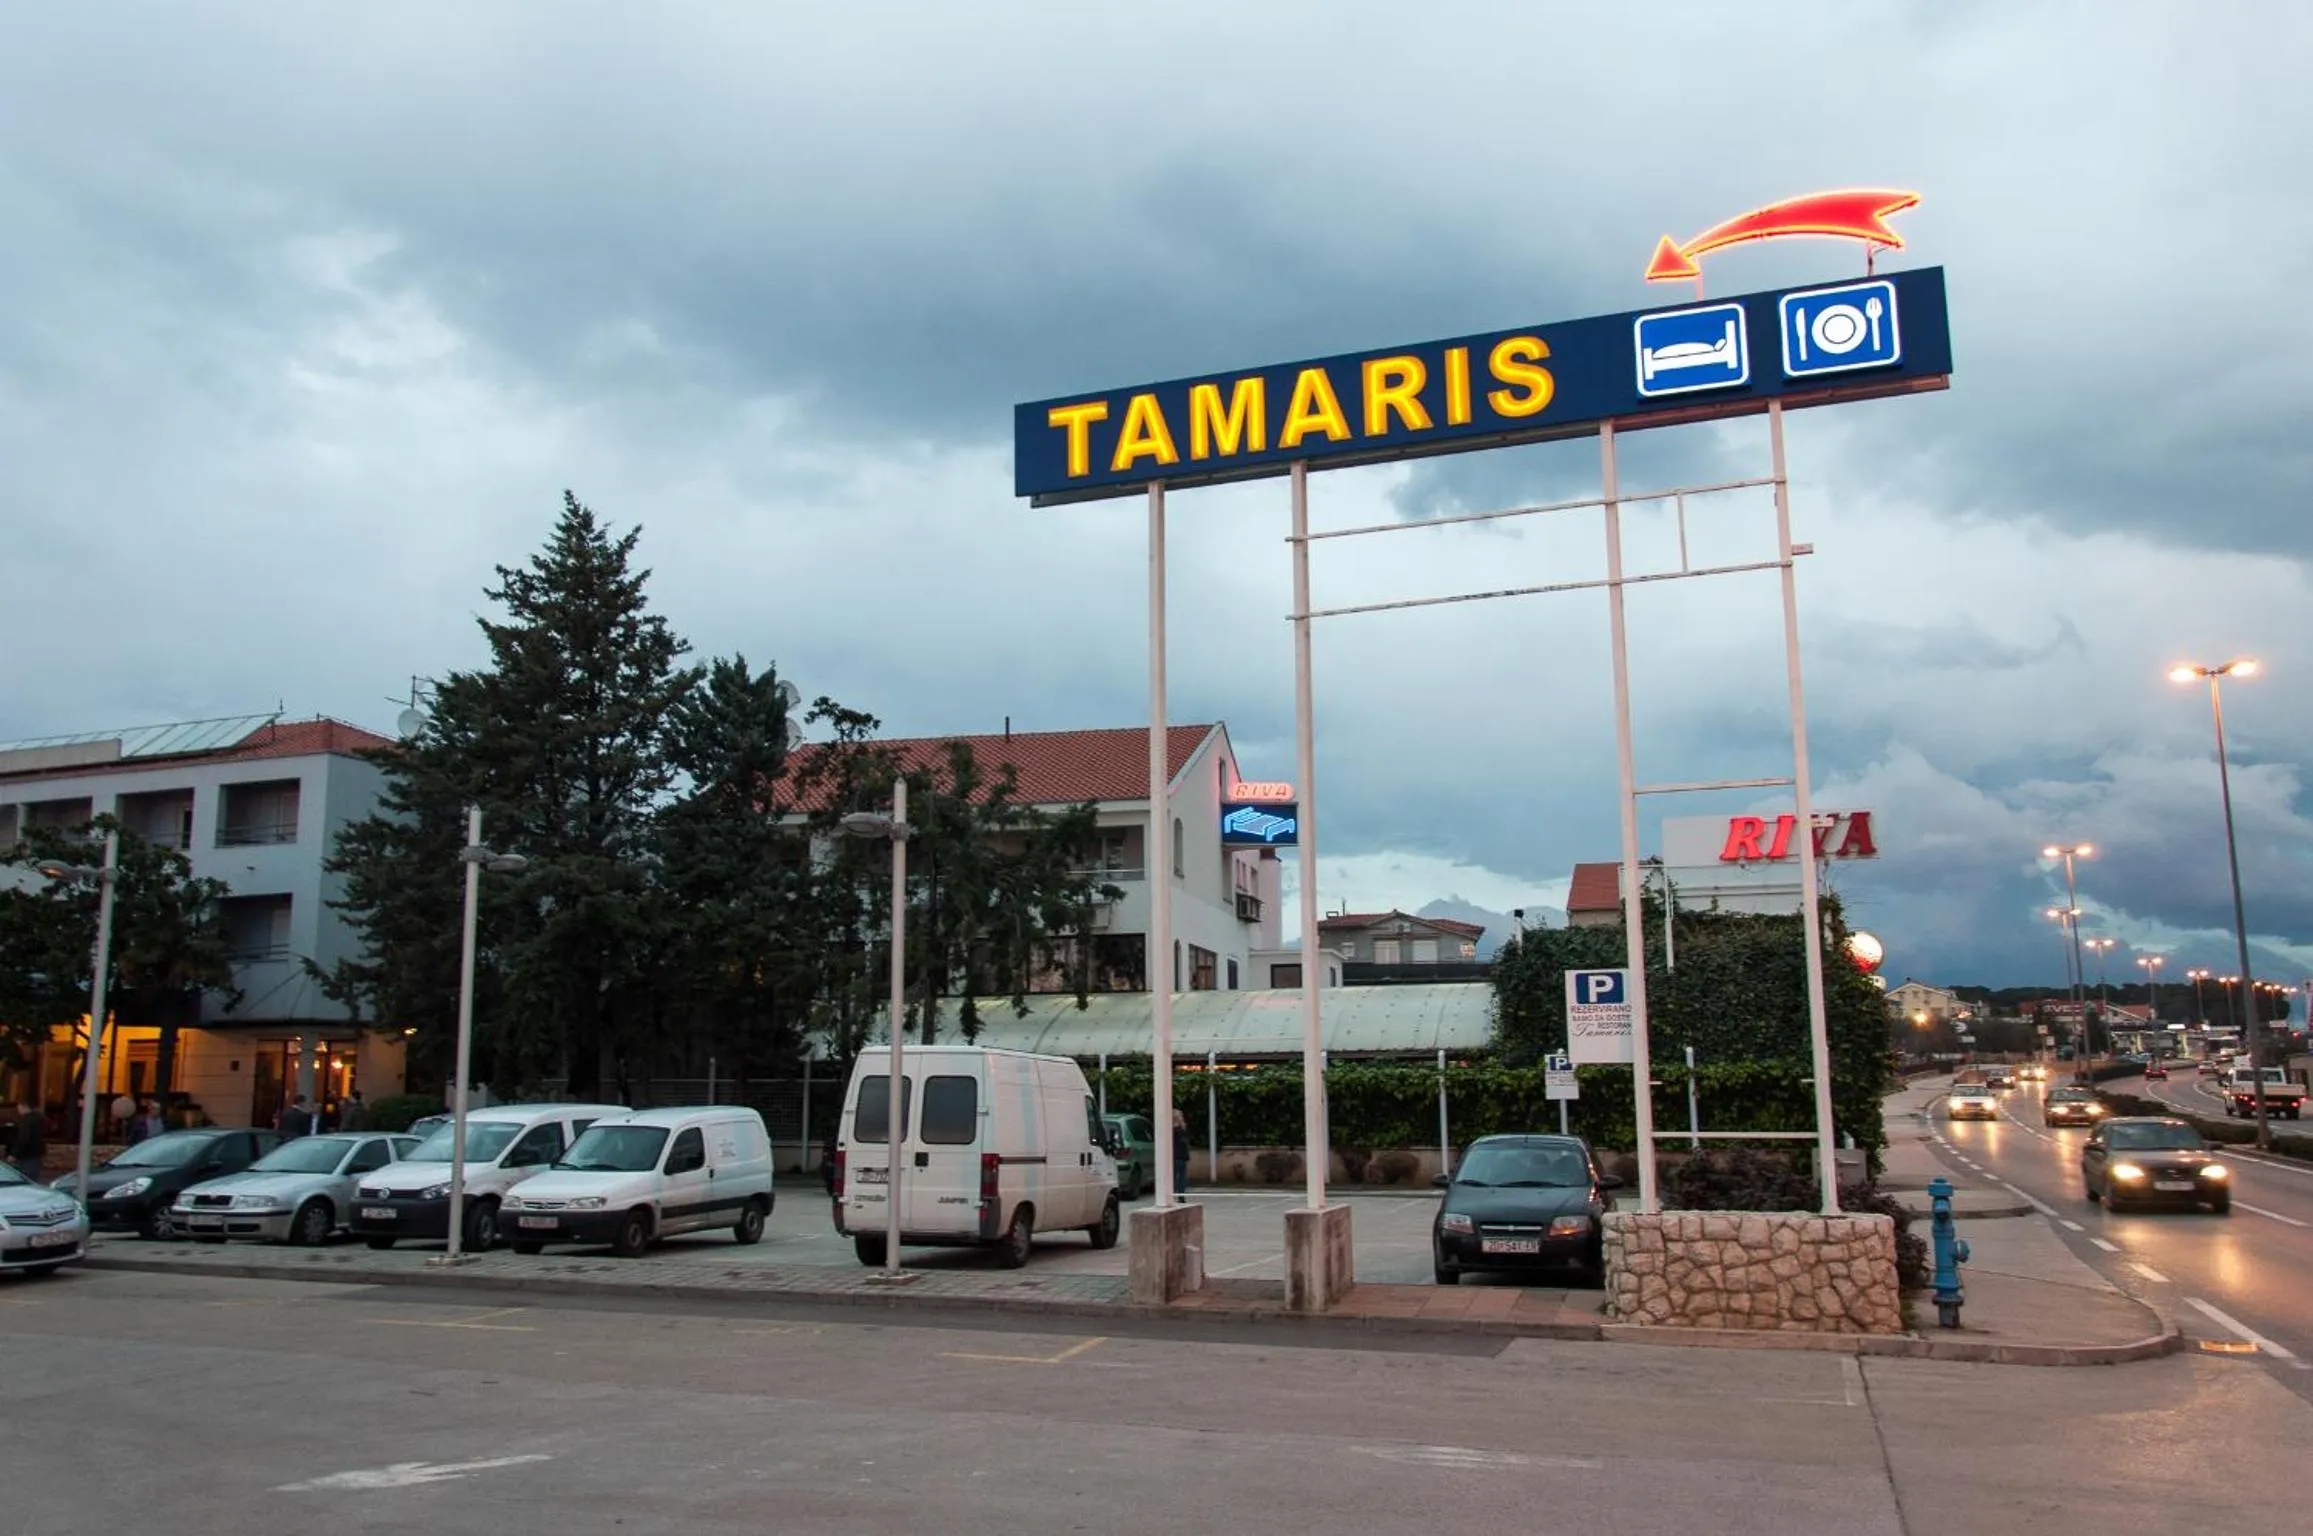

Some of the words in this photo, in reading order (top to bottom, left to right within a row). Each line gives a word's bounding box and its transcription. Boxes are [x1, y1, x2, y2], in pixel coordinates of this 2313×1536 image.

[1048, 335, 1556, 478] TAMARIS
[1235, 784, 1288, 797] RIVA
[1719, 810, 1878, 861] RIVA
[1587, 974, 1614, 1003] P
[1570, 1004, 1633, 1014] REZERVIRANO
[1555, 1057, 1568, 1070] P
